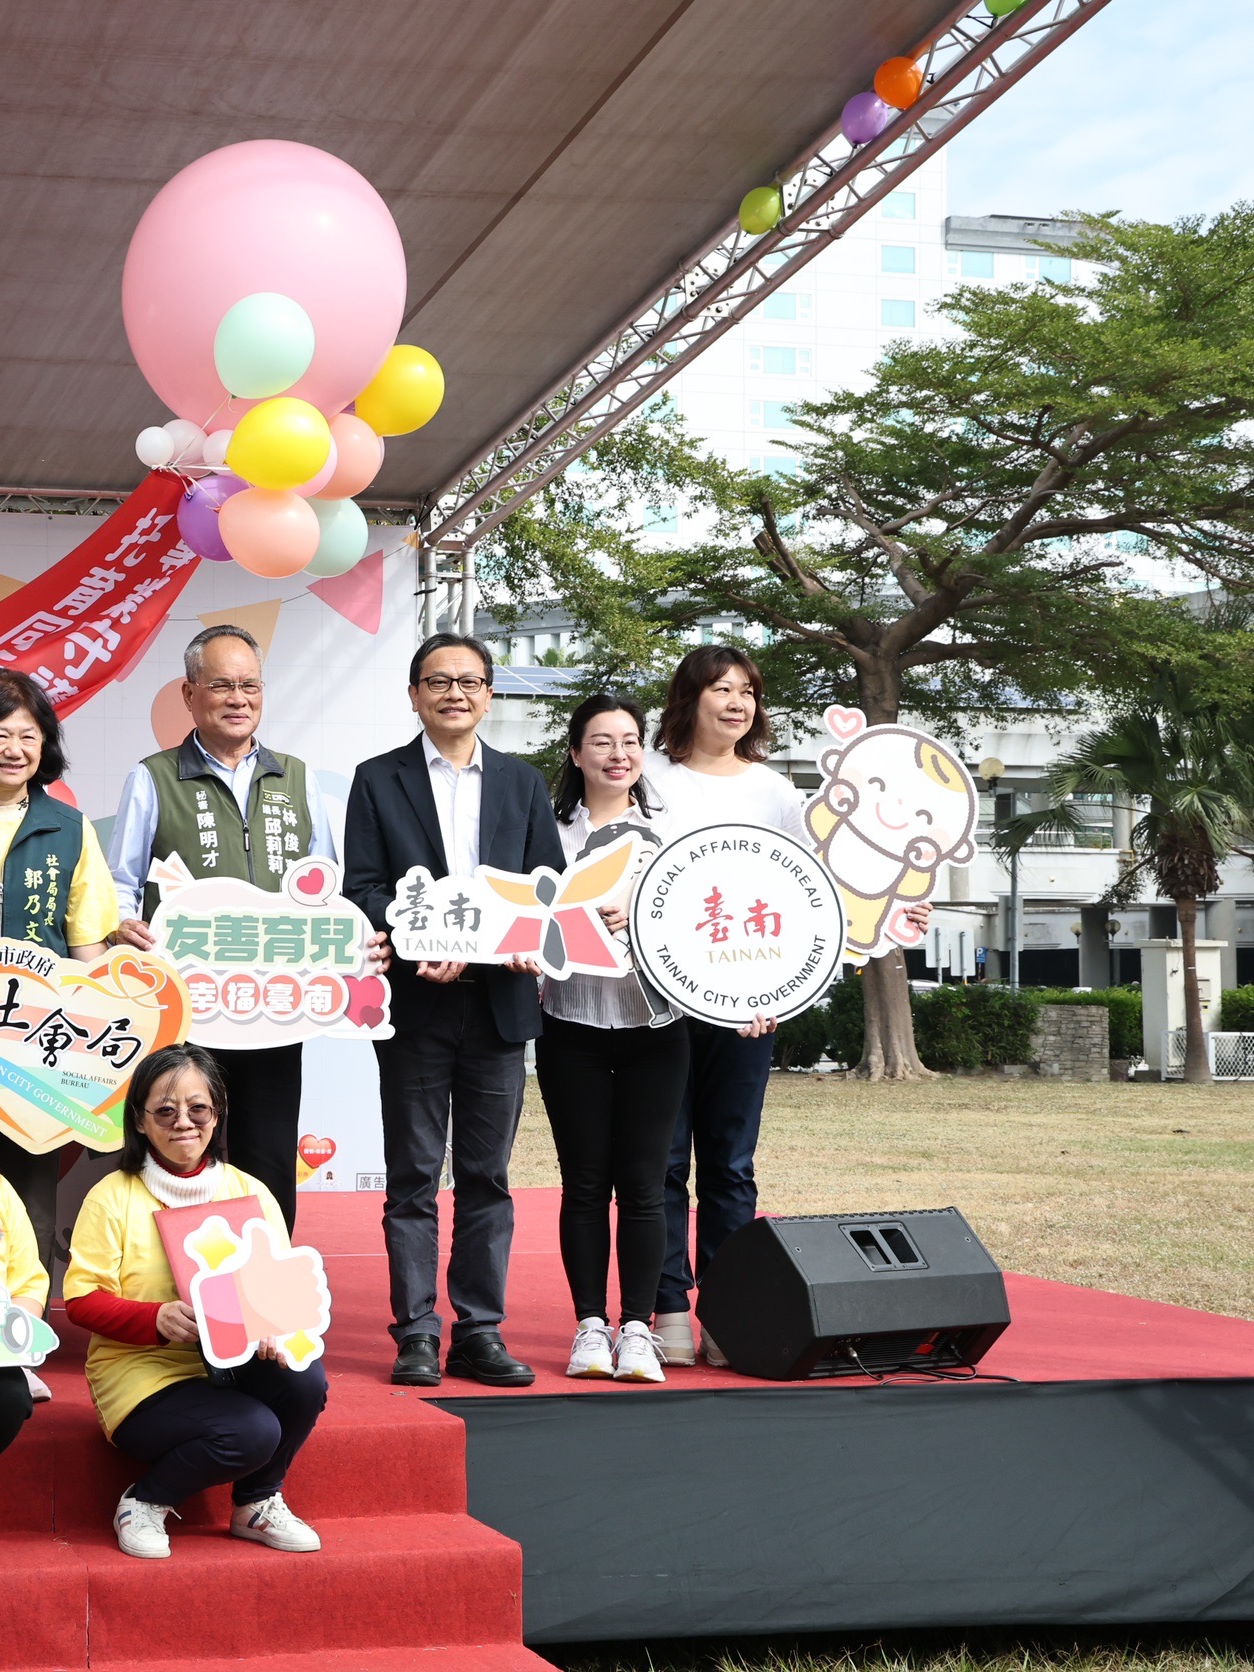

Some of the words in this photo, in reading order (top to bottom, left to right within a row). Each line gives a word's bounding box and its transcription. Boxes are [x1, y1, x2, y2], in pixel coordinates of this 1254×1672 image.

[196, 812, 220, 868] 陳明才
[264, 818, 283, 875] 邱莉莉
[23, 867, 44, 942] 郭乃文
[44, 854, 61, 926] 社會局局長
[395, 874, 482, 933] 臺南
[651, 864, 686, 920] SOCIAL
[689, 839, 762, 863] AFFAIRS
[769, 849, 823, 909] BUREAU
[165, 914, 355, 965] 友善育兒
[695, 886, 782, 944] 臺南
[402, 937, 479, 955] TAINAN
[656, 944, 699, 994] TAINAN
[703, 990, 740, 1008] CITY
[747, 934, 827, 1008] GOVERNMENT
[705, 946, 782, 964] TAINAN
[976, 947, 984, 957] P
[190, 981, 335, 1016] 幸福臺南
[7, 1071, 35, 1092] CITY
[33, 1086, 108, 1137] GOVERNMENT
[61, 1078, 90, 1089] BUREAU
[62, 1070, 90, 1082] SOCIAL
[90, 1074, 118, 1086] AFFAIRS
[359, 1176, 385, 1190] 廣告
